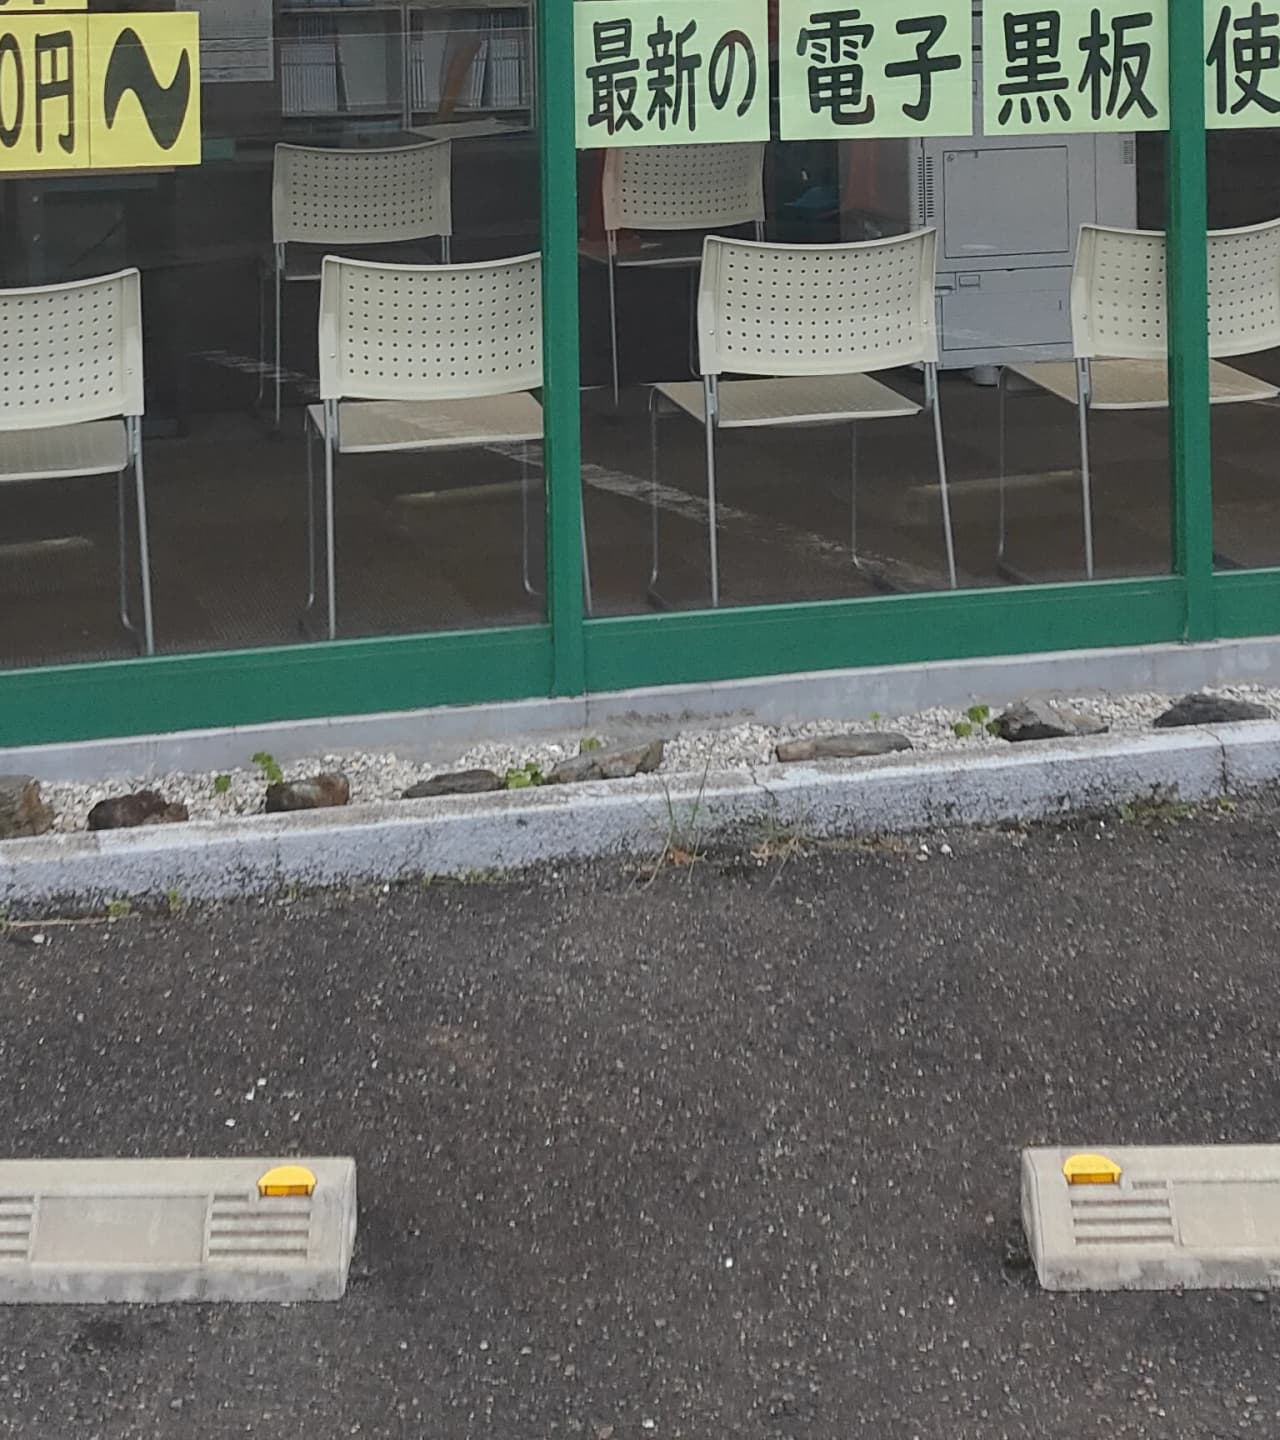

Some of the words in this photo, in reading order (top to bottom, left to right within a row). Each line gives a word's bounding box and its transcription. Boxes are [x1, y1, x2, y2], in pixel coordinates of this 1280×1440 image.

[585, 15, 758, 136] 最新の
[795, 8, 962, 127] 電子
[996, 8, 1160, 127] 黒板
